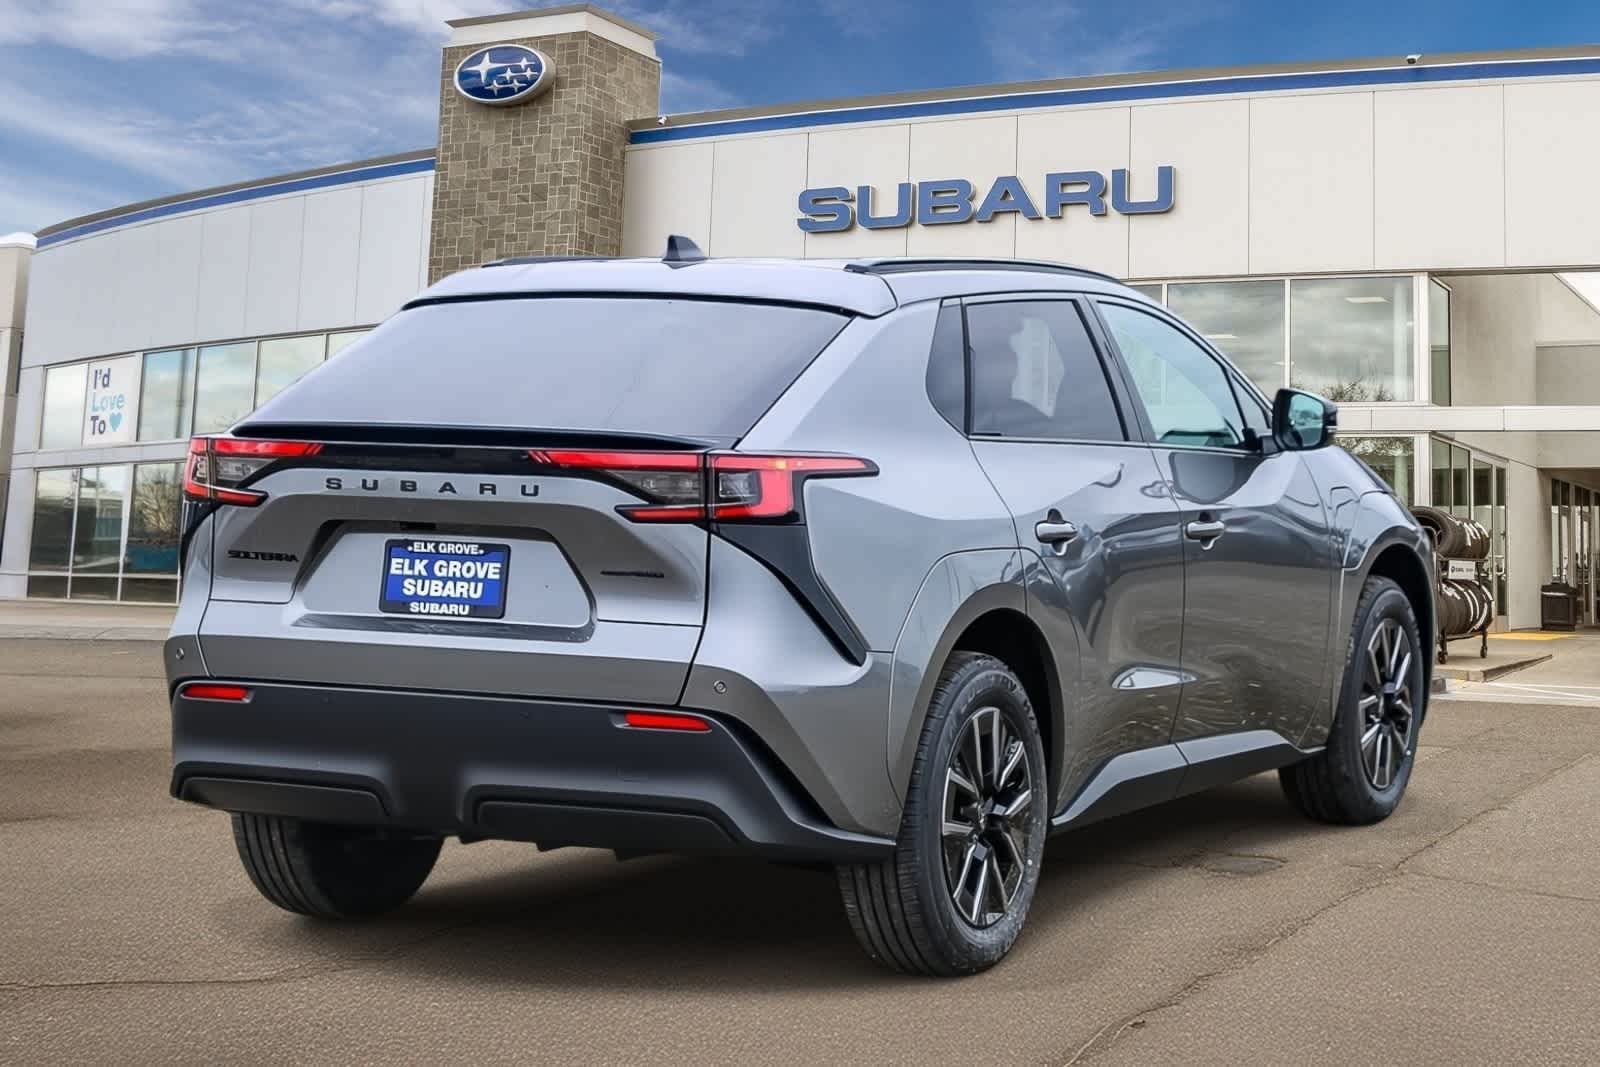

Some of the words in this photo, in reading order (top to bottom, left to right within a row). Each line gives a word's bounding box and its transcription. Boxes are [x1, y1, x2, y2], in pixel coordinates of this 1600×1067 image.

[797, 166, 1176, 233] SUBARU
[94, 368, 111, 389] I'd
[92, 392, 125, 412] Love
[91, 415, 106, 435] To
[326, 477, 540, 497] SUBARU
[414, 542, 436, 553] ELK
[438, 542, 479, 554] GROVE
[390, 558, 428, 576] ELK
[433, 560, 501, 579] GROVE
[402, 578, 483, 599] SUBARU
[409, 602, 470, 615] SUBARU
